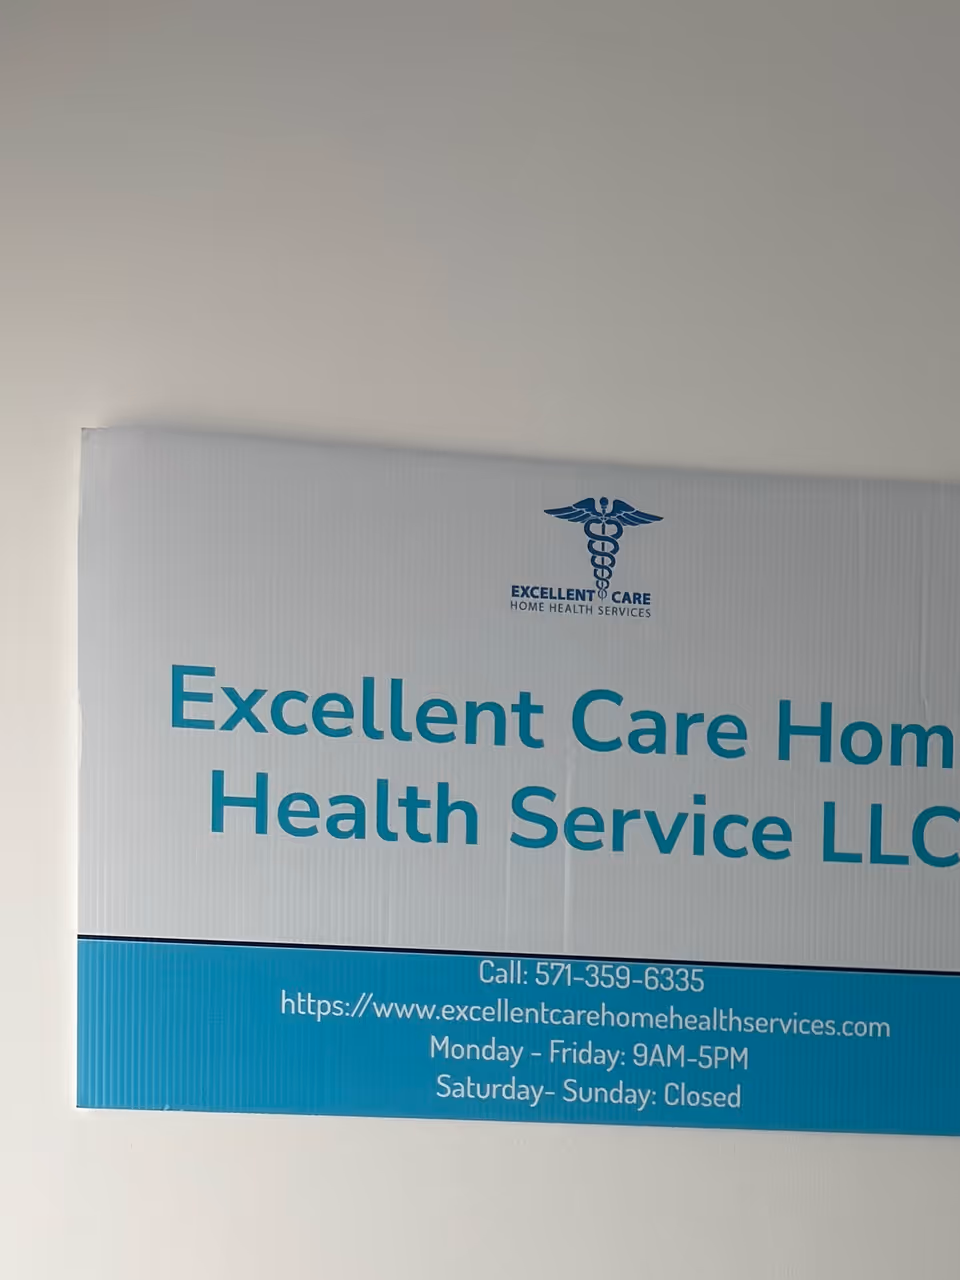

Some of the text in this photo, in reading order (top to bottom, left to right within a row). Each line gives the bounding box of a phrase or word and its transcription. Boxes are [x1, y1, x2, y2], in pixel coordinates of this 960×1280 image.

[510, 600, 652, 618] HOME HEALTH SERVICES
[511, 585, 651, 605] EXCELLENT CARE
[170, 663, 546, 750] Excellent
[571, 688, 749, 760] Care
[210, 769, 480, 846] Health
[509, 784, 793, 861] Service
[479, 959, 705, 992] Call: 571-359-6335
[280, 989, 891, 1037] https://www.excellentcarehomehealthservices.com
[429, 1035, 524, 1068] Monday
[549, 1040, 627, 1072] Friday:
[633, 1043, 749, 1071] 9AM-5PM
[563, 1079, 657, 1111] Sunday:
[663, 1081, 742, 1109] Closed
